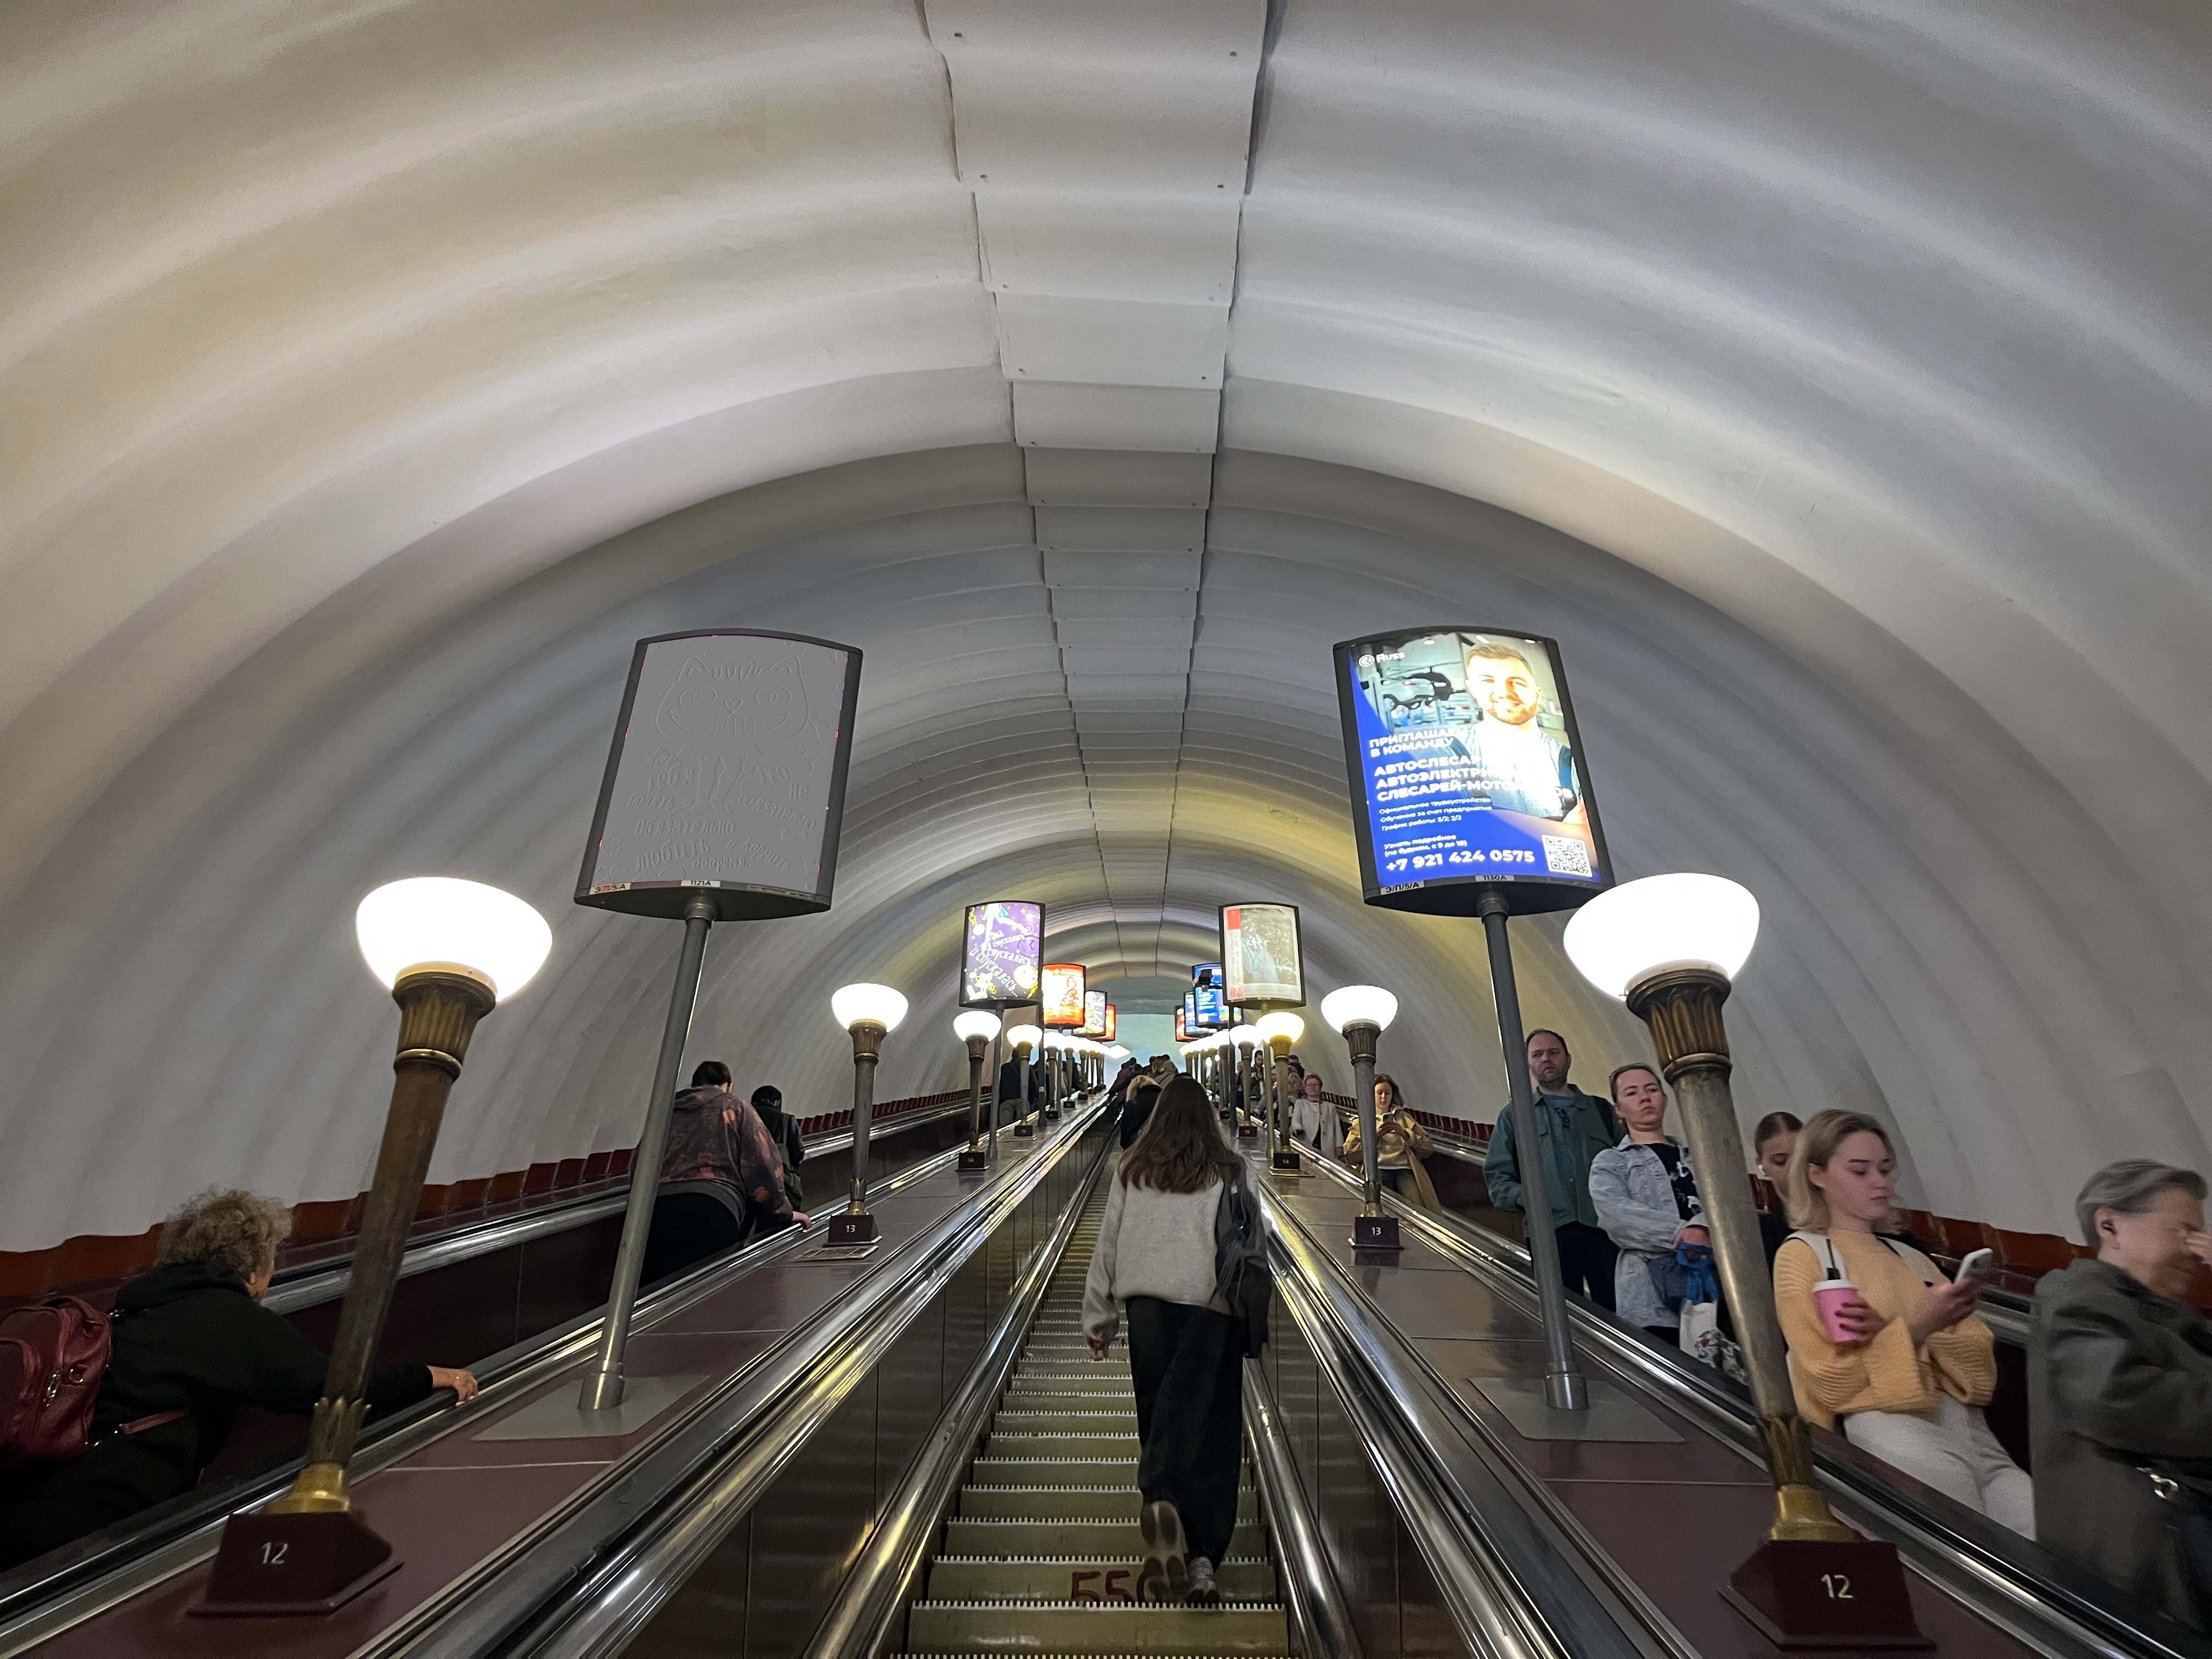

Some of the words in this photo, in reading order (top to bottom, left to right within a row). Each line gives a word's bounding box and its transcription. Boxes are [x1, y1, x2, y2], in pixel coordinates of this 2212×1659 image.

[1376, 652, 1406, 663] Russ
[1370, 748, 1381, 758] В
[1383, 737, 1454, 755] КОМАНДУ
[1374, 755, 1483, 776] АВТОСЛЕСАР
[1376, 768, 1493, 789] АВТОЭЛЕКТРИ
[1386, 859, 1408, 871] +7
[1413, 853, 1443, 868] 921
[1449, 850, 1486, 863] 424
[1490, 849, 1535, 864] 0575
[845, 1224, 856, 1233] 13
[1372, 1227, 1381, 1235] 13
[261, 1542, 289, 1565] 12
[1821, 1574, 1854, 1598] 12
